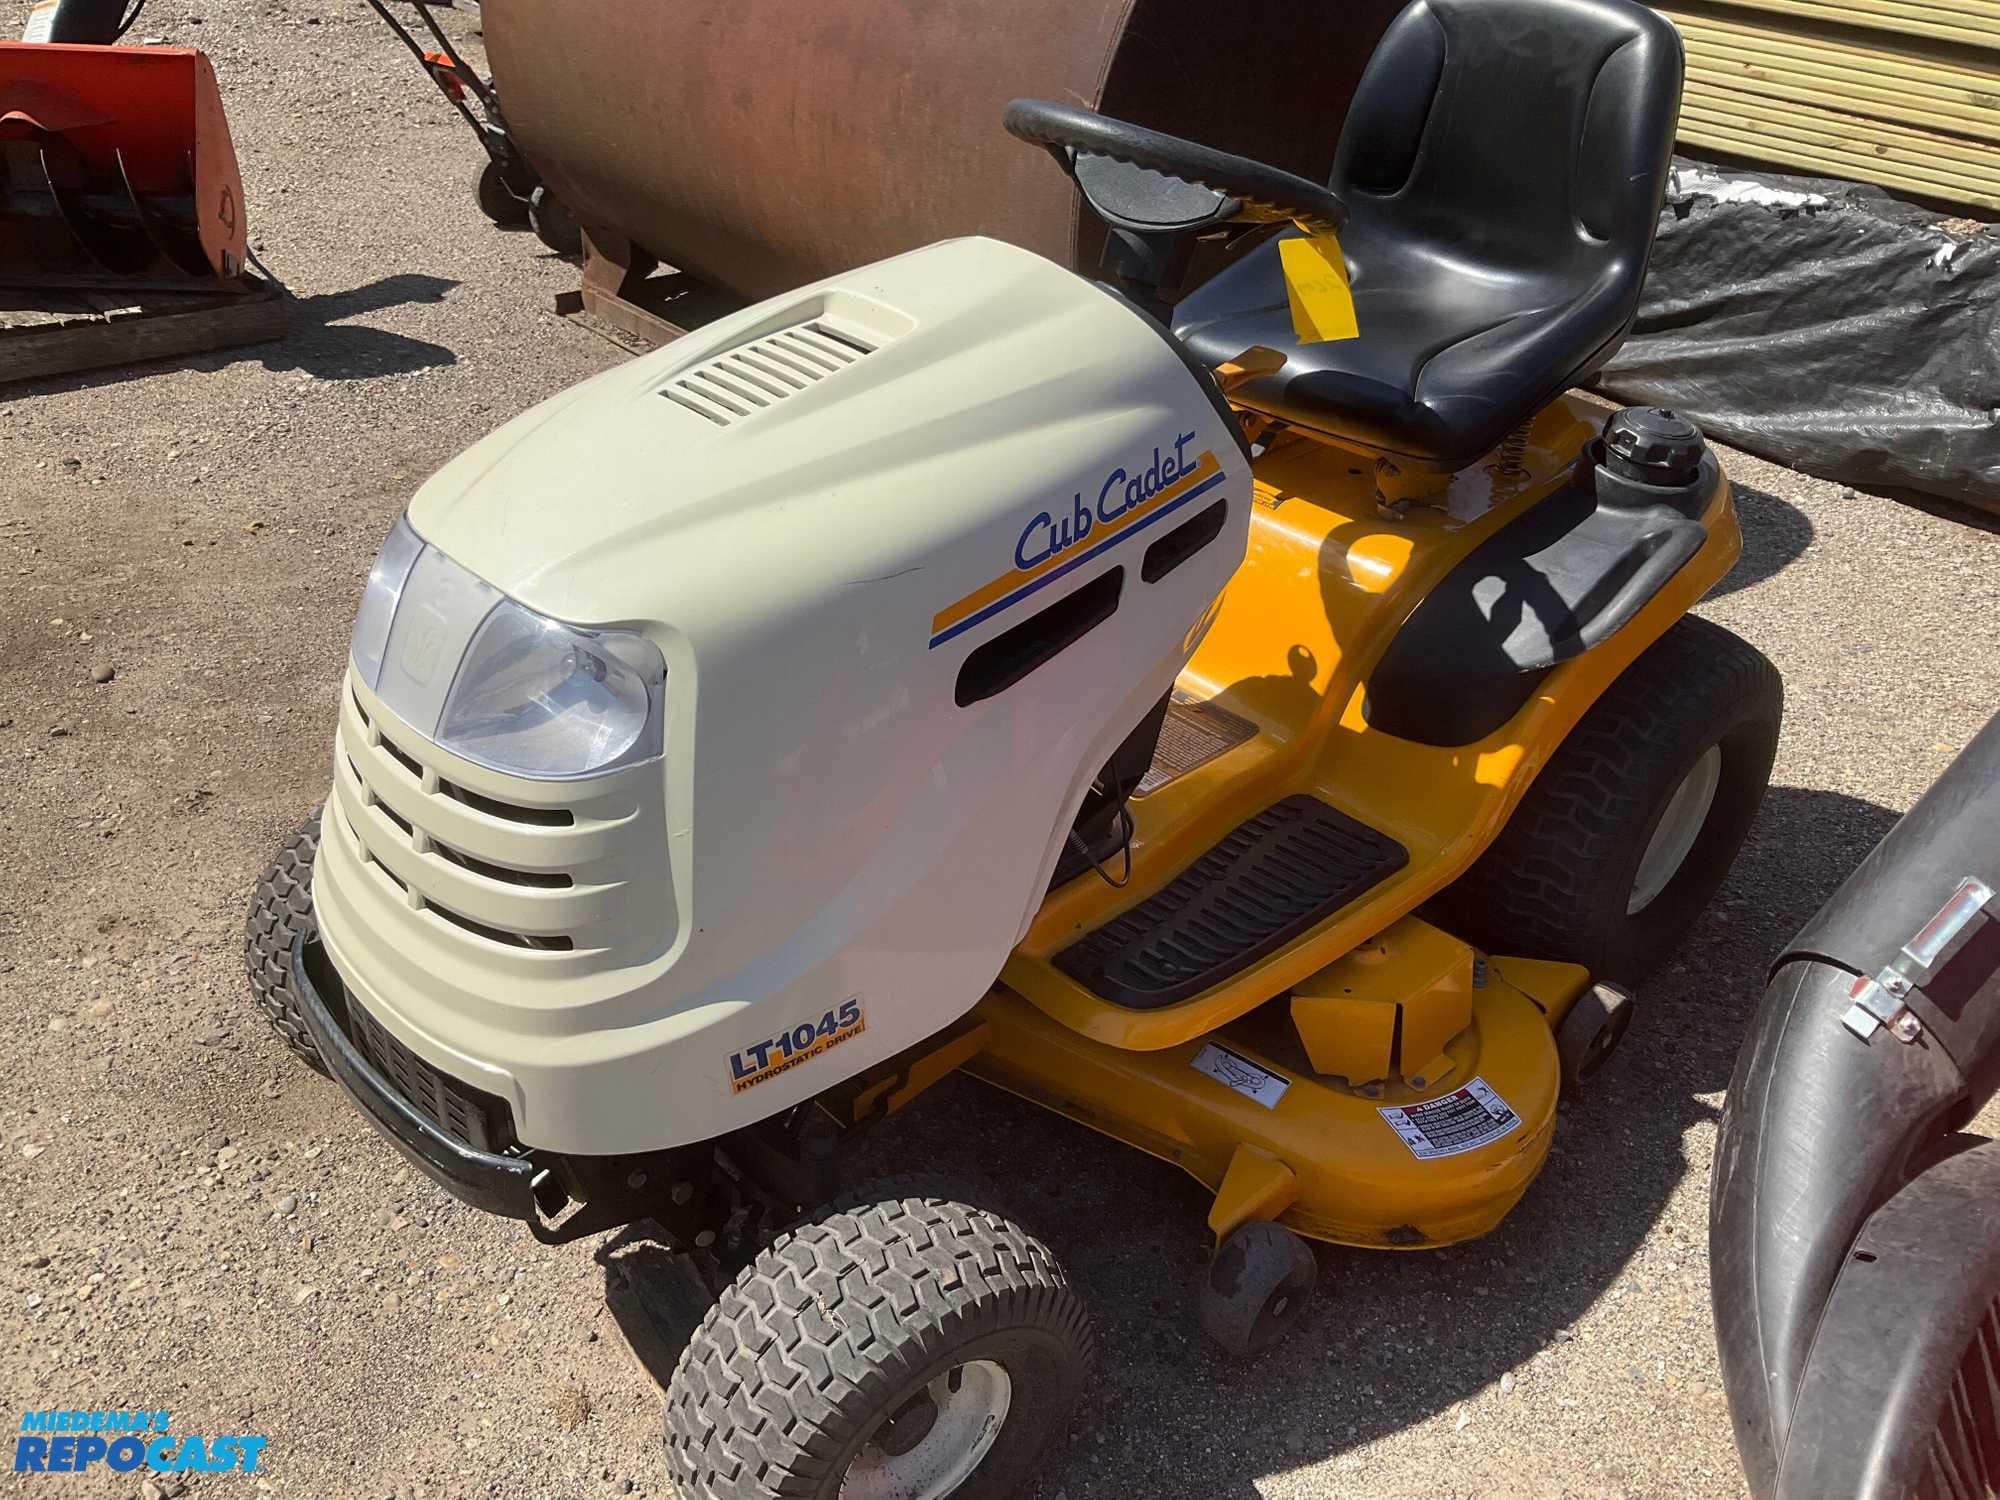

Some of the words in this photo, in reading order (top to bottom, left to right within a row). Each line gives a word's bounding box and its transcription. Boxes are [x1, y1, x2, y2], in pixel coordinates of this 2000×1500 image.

[1014, 492, 1093, 571] Cub
[1097, 430, 1197, 523] Cadet
[730, 998, 861, 1081] LT1045
[736, 1045, 823, 1093] HYDROSTATIC
[826, 1024, 862, 1050] DRIVE
[1422, 1094, 1459, 1110] DANGER
